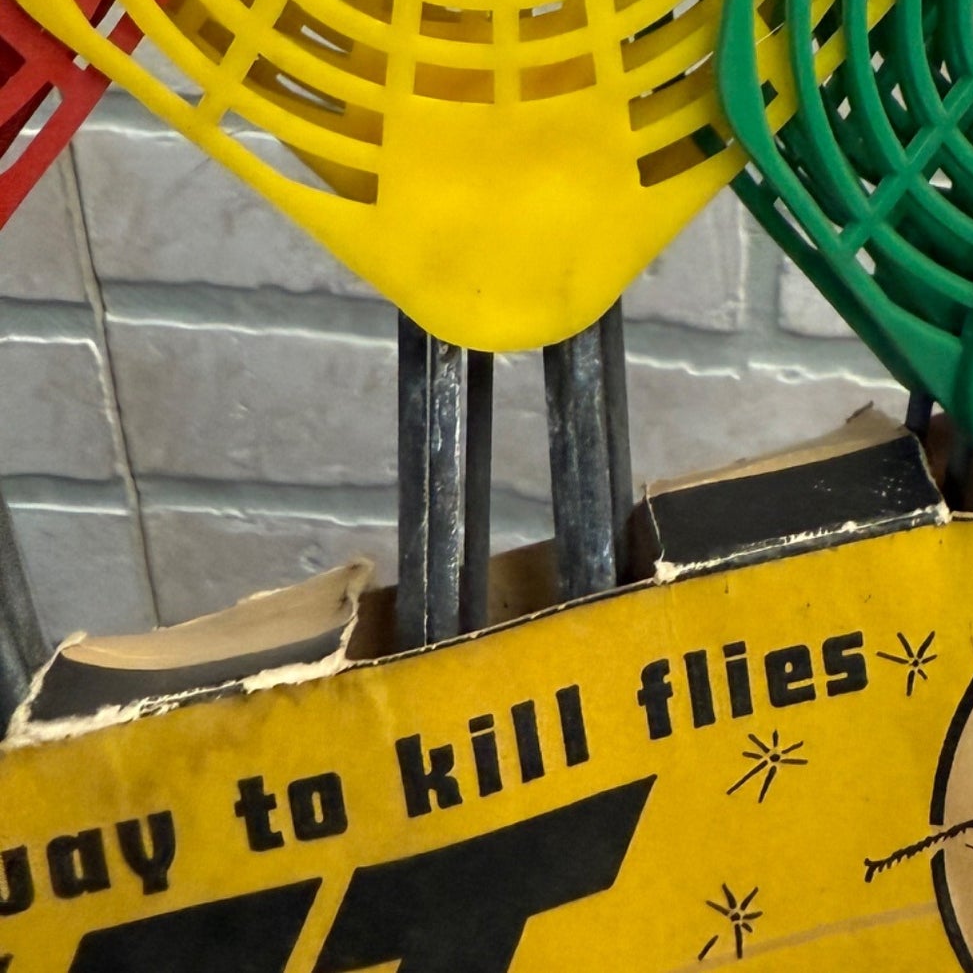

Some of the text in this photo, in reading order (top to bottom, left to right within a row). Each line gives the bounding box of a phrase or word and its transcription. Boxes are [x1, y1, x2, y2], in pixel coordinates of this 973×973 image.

[234, 771, 348, 852] to
[395, 684, 590, 818] kill
[637, 630, 869, 741] flies
